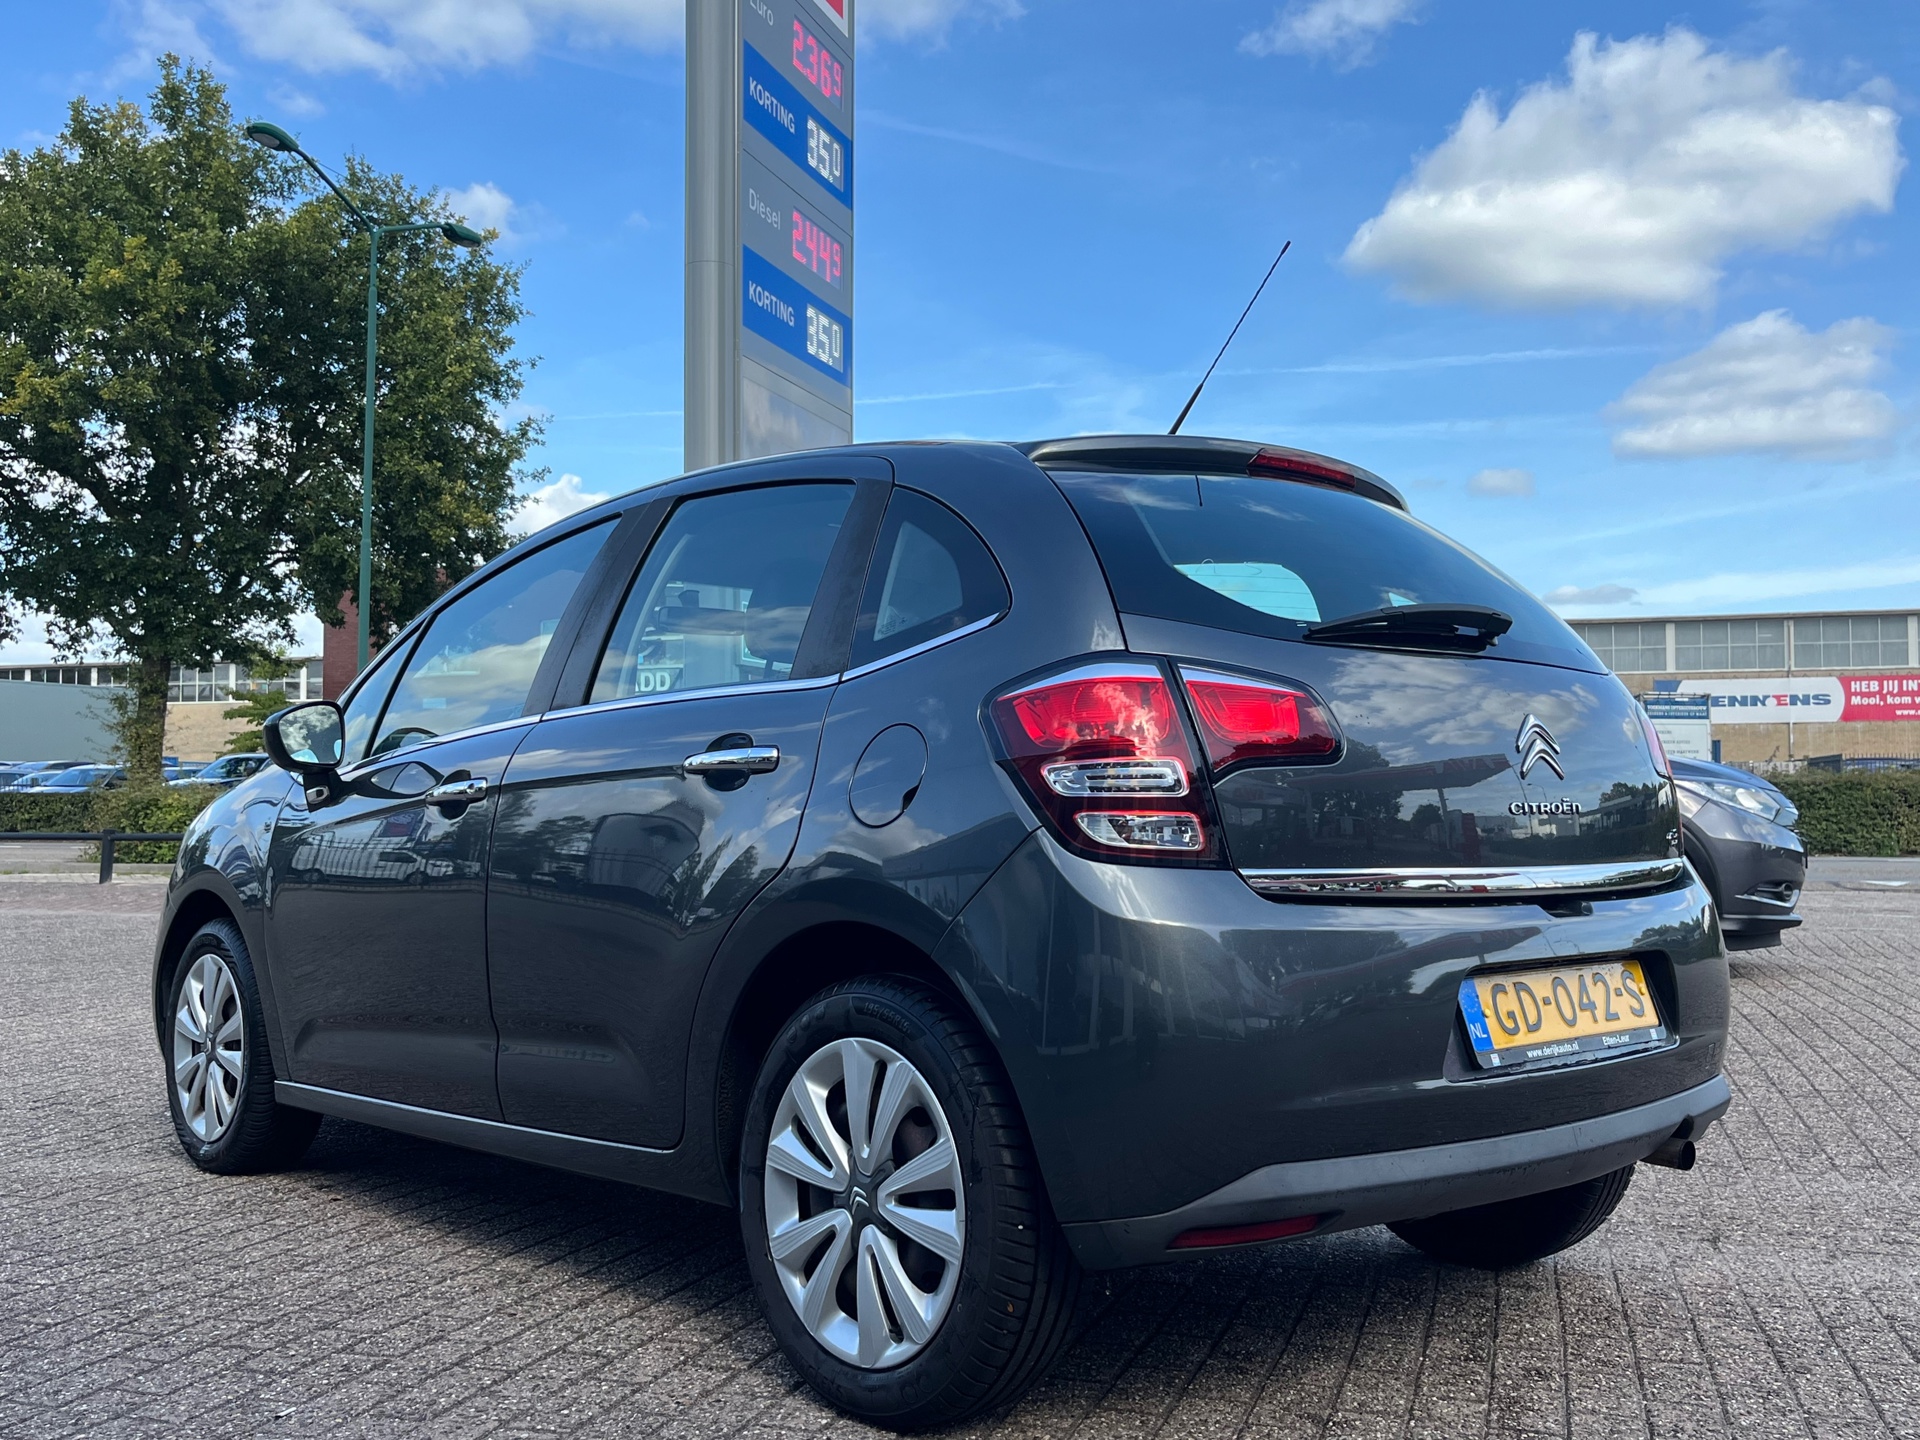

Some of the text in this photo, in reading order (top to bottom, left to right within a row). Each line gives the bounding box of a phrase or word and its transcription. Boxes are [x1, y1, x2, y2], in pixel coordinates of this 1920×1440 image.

[749, 77, 795, 135] KORTING
[749, 188, 781, 230] Diesel
[748, 280, 795, 327] KORTING
[1850, 680, 1880, 693] HEB
[1882, 680, 1899, 694] JIJ
[1850, 694, 1884, 706] Mooi,
[1886, 694, 1912, 705] kom
[1491, 968, 1645, 1036] GD-042-S
[1469, 1022, 1488, 1040] NL
[1526, 1040, 1580, 1059] www.derijkauto.nl
